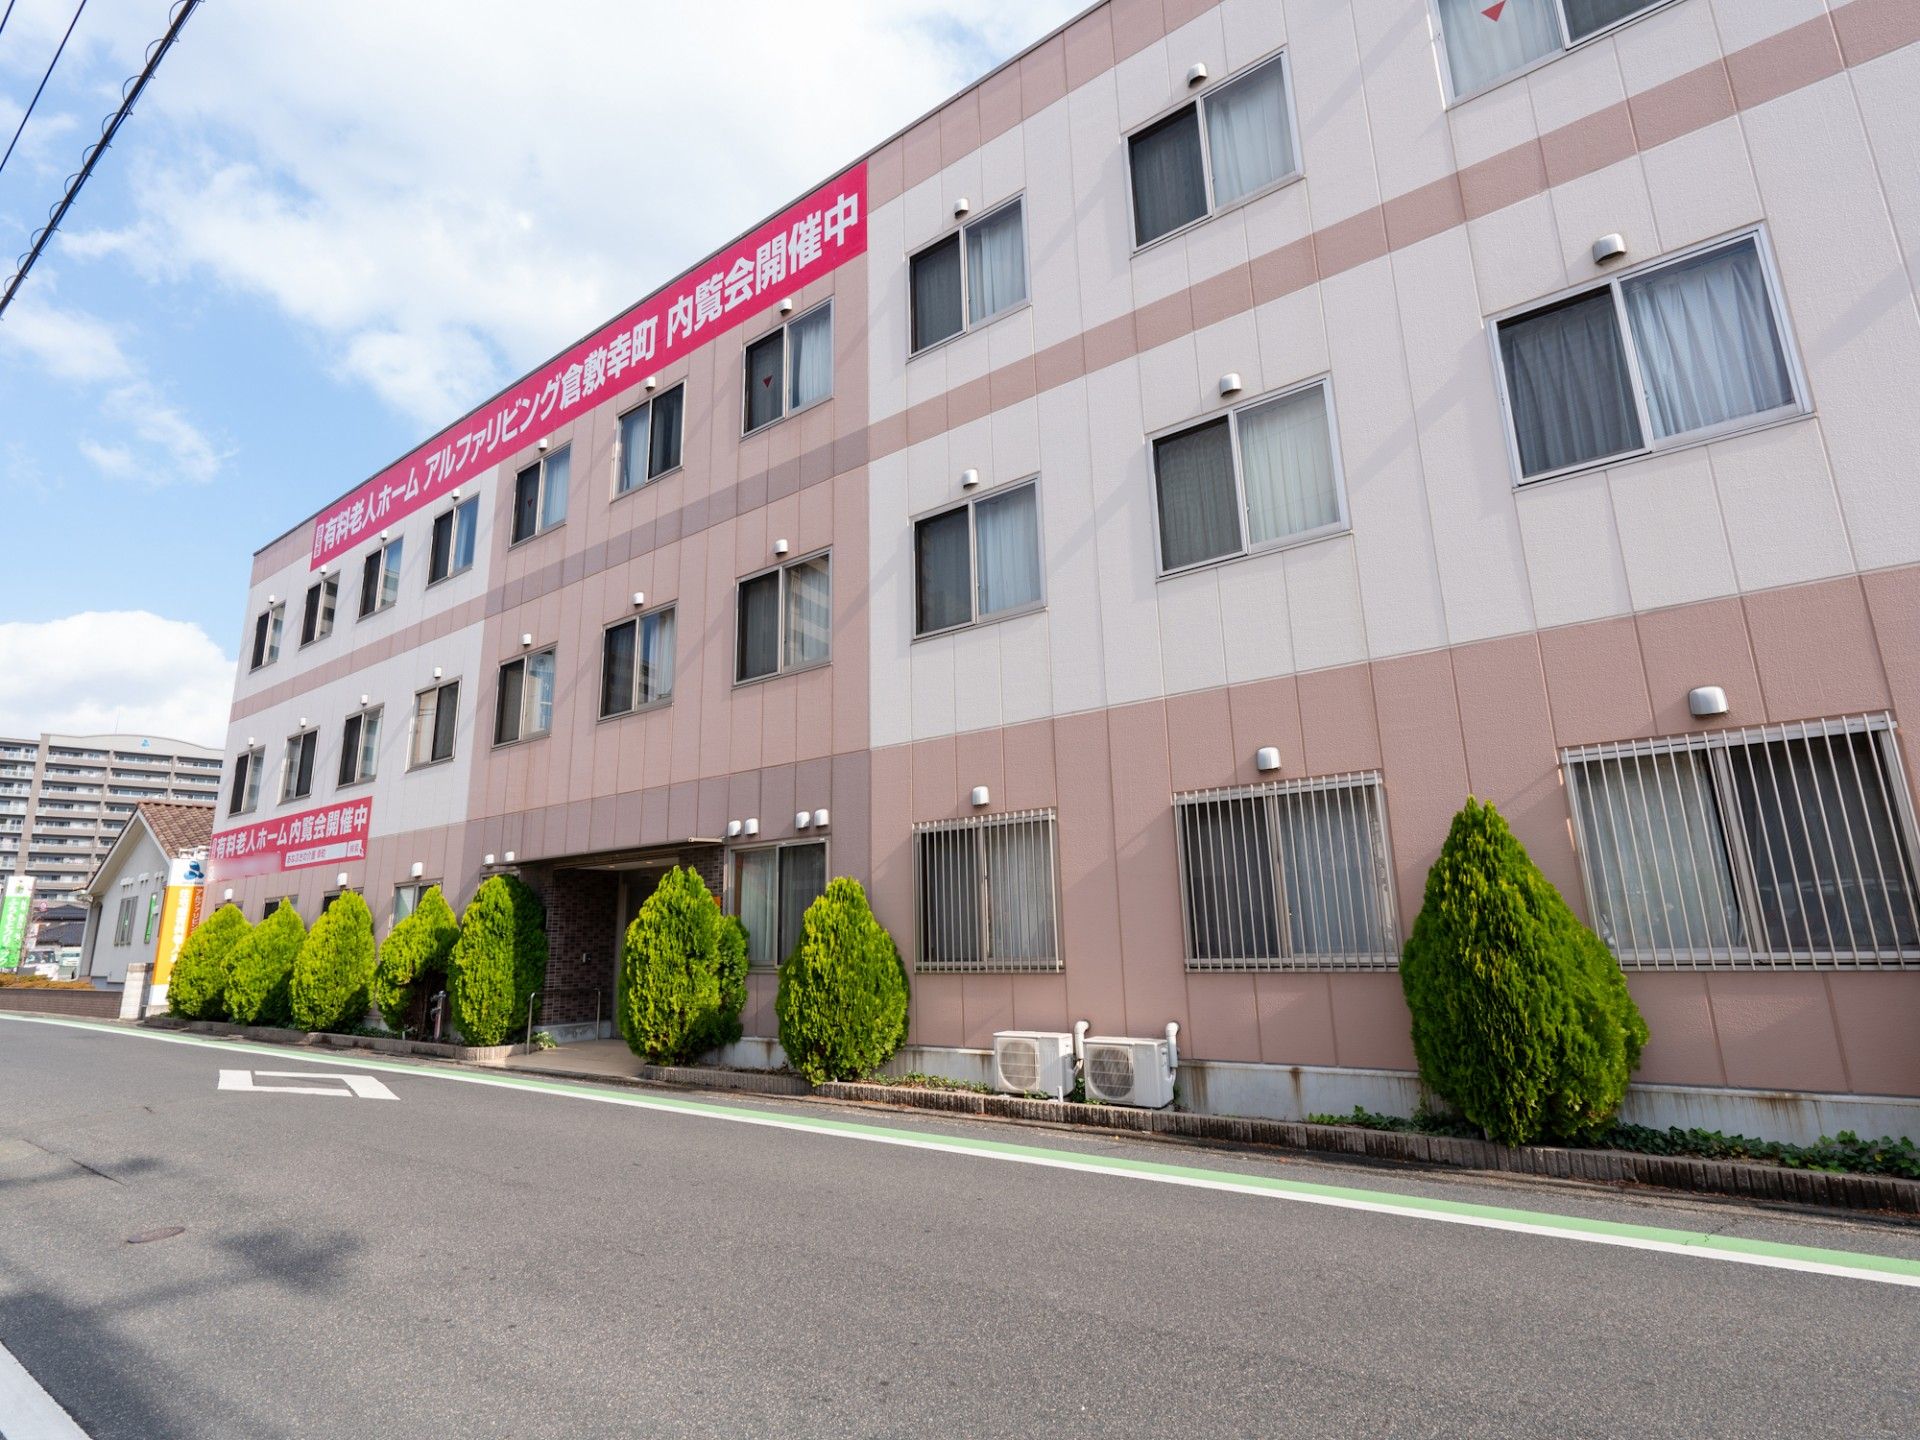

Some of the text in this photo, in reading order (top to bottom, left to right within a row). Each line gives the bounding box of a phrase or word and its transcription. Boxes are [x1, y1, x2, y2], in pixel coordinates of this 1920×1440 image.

[323, 191, 859, 552] 有料老人ホーム アルファリビング倉敷幸町 内覧会開催中
[216, 823, 288, 859] 有料老人ホーム
[289, 804, 368, 844] 内覧会開催中
